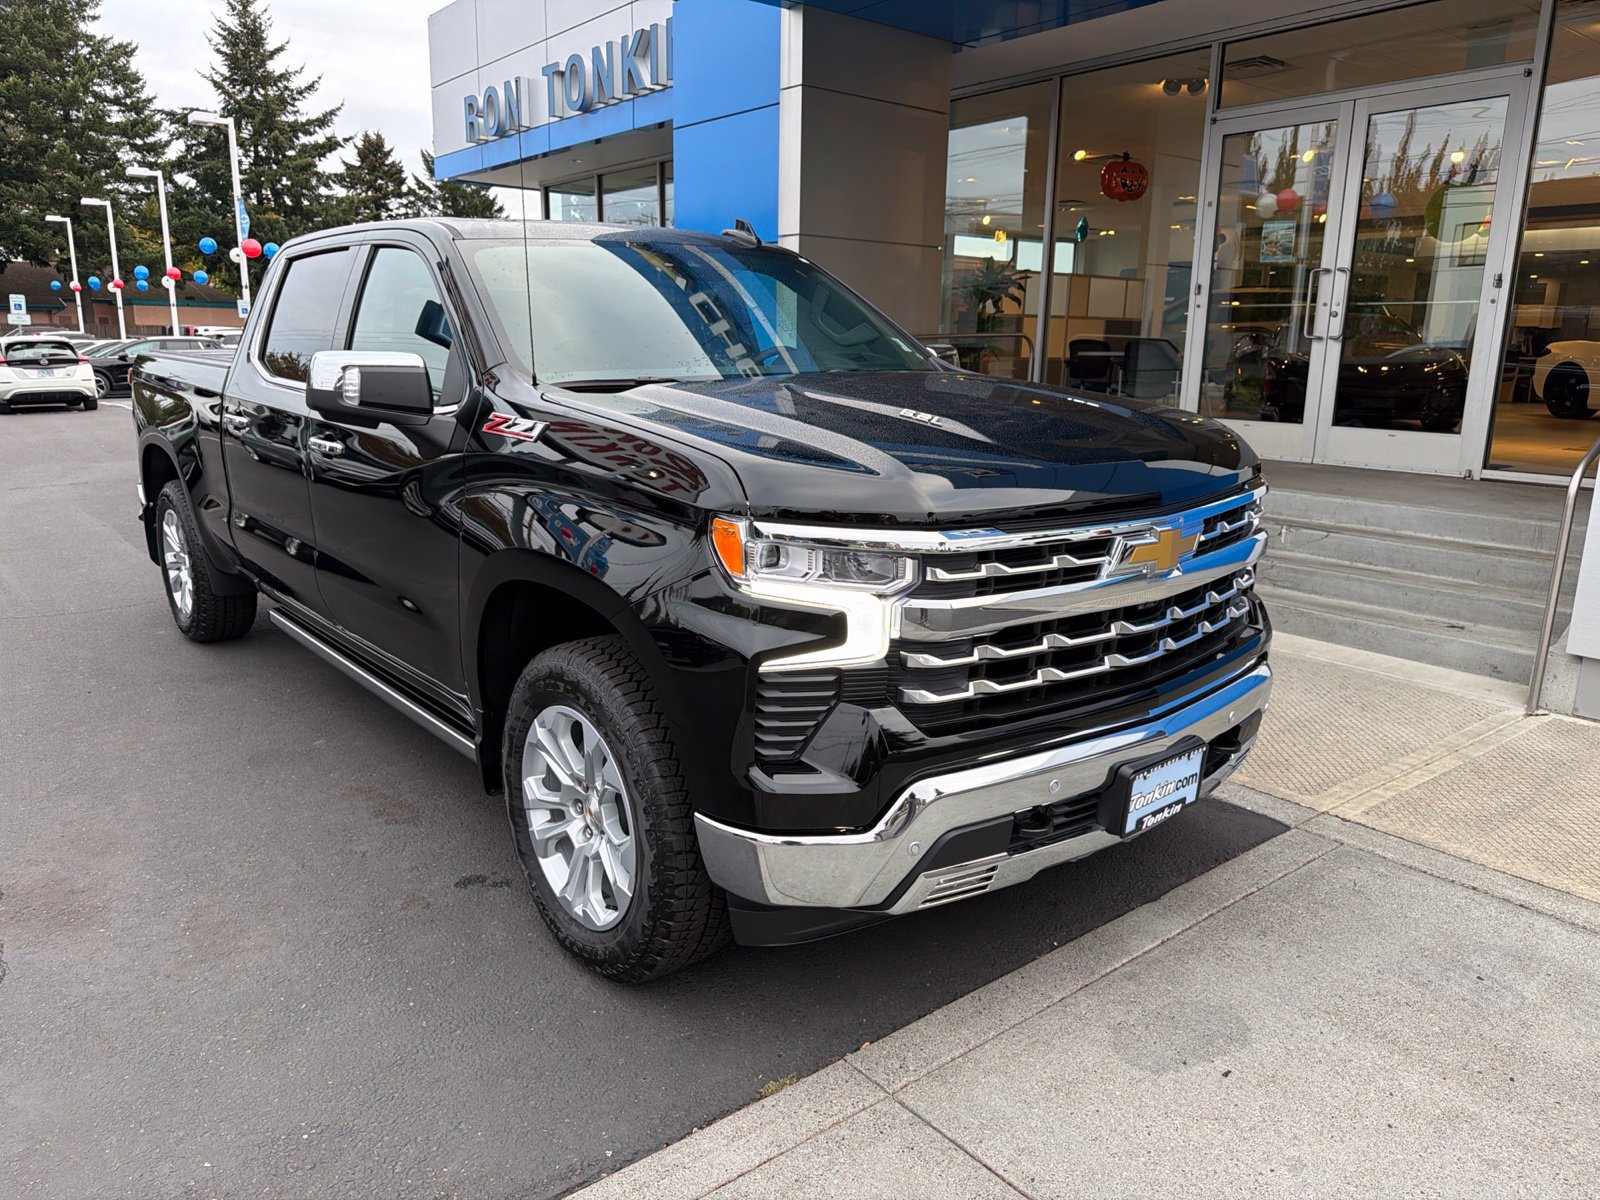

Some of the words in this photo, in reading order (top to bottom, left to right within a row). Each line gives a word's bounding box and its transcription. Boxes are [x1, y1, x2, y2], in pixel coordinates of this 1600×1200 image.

[464, 77, 528, 143] RON
[482, 411, 550, 442] Z71
[1128, 772, 1198, 814] Tonkin.com
[1141, 803, 1183, 830] Tonkin
